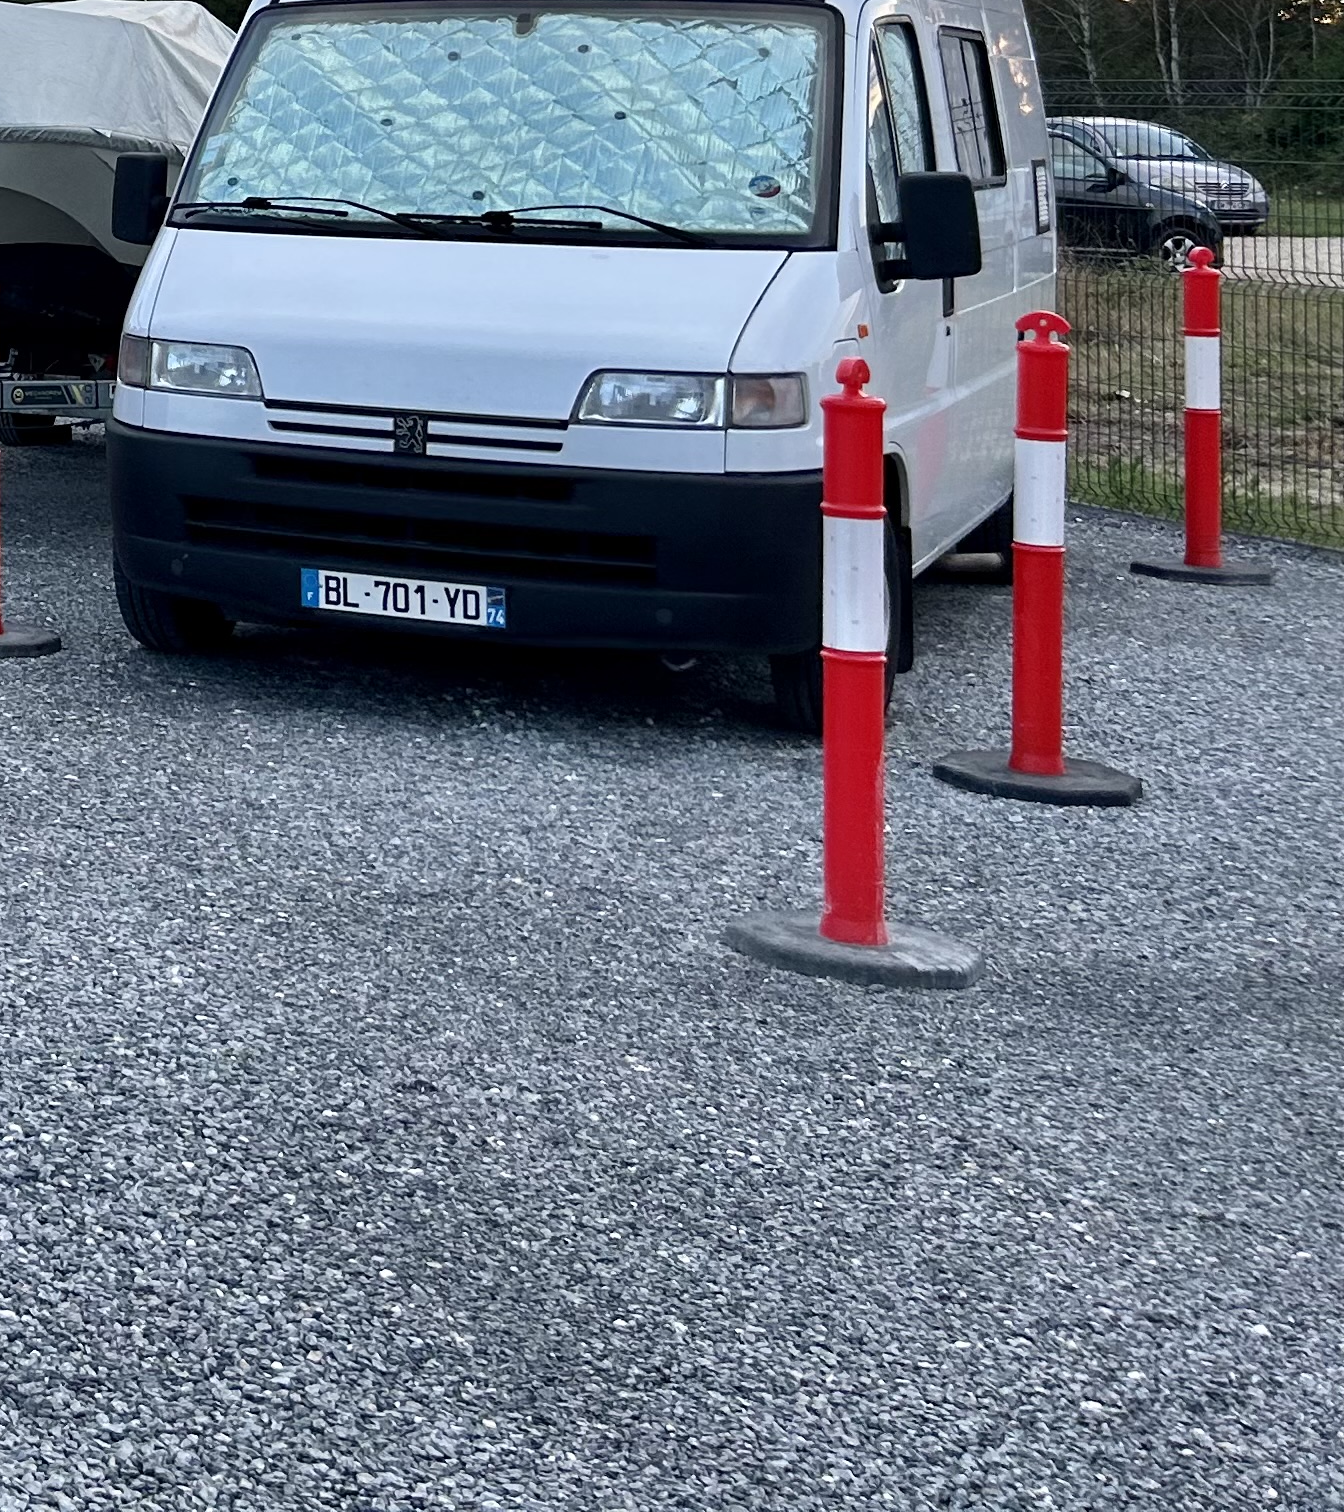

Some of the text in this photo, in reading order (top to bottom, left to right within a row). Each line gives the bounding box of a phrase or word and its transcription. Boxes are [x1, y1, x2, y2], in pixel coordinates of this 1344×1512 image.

[306, 591, 314, 601] F
[324, 575, 480, 620] BL-701-YD
[487, 607, 505, 625] 74
